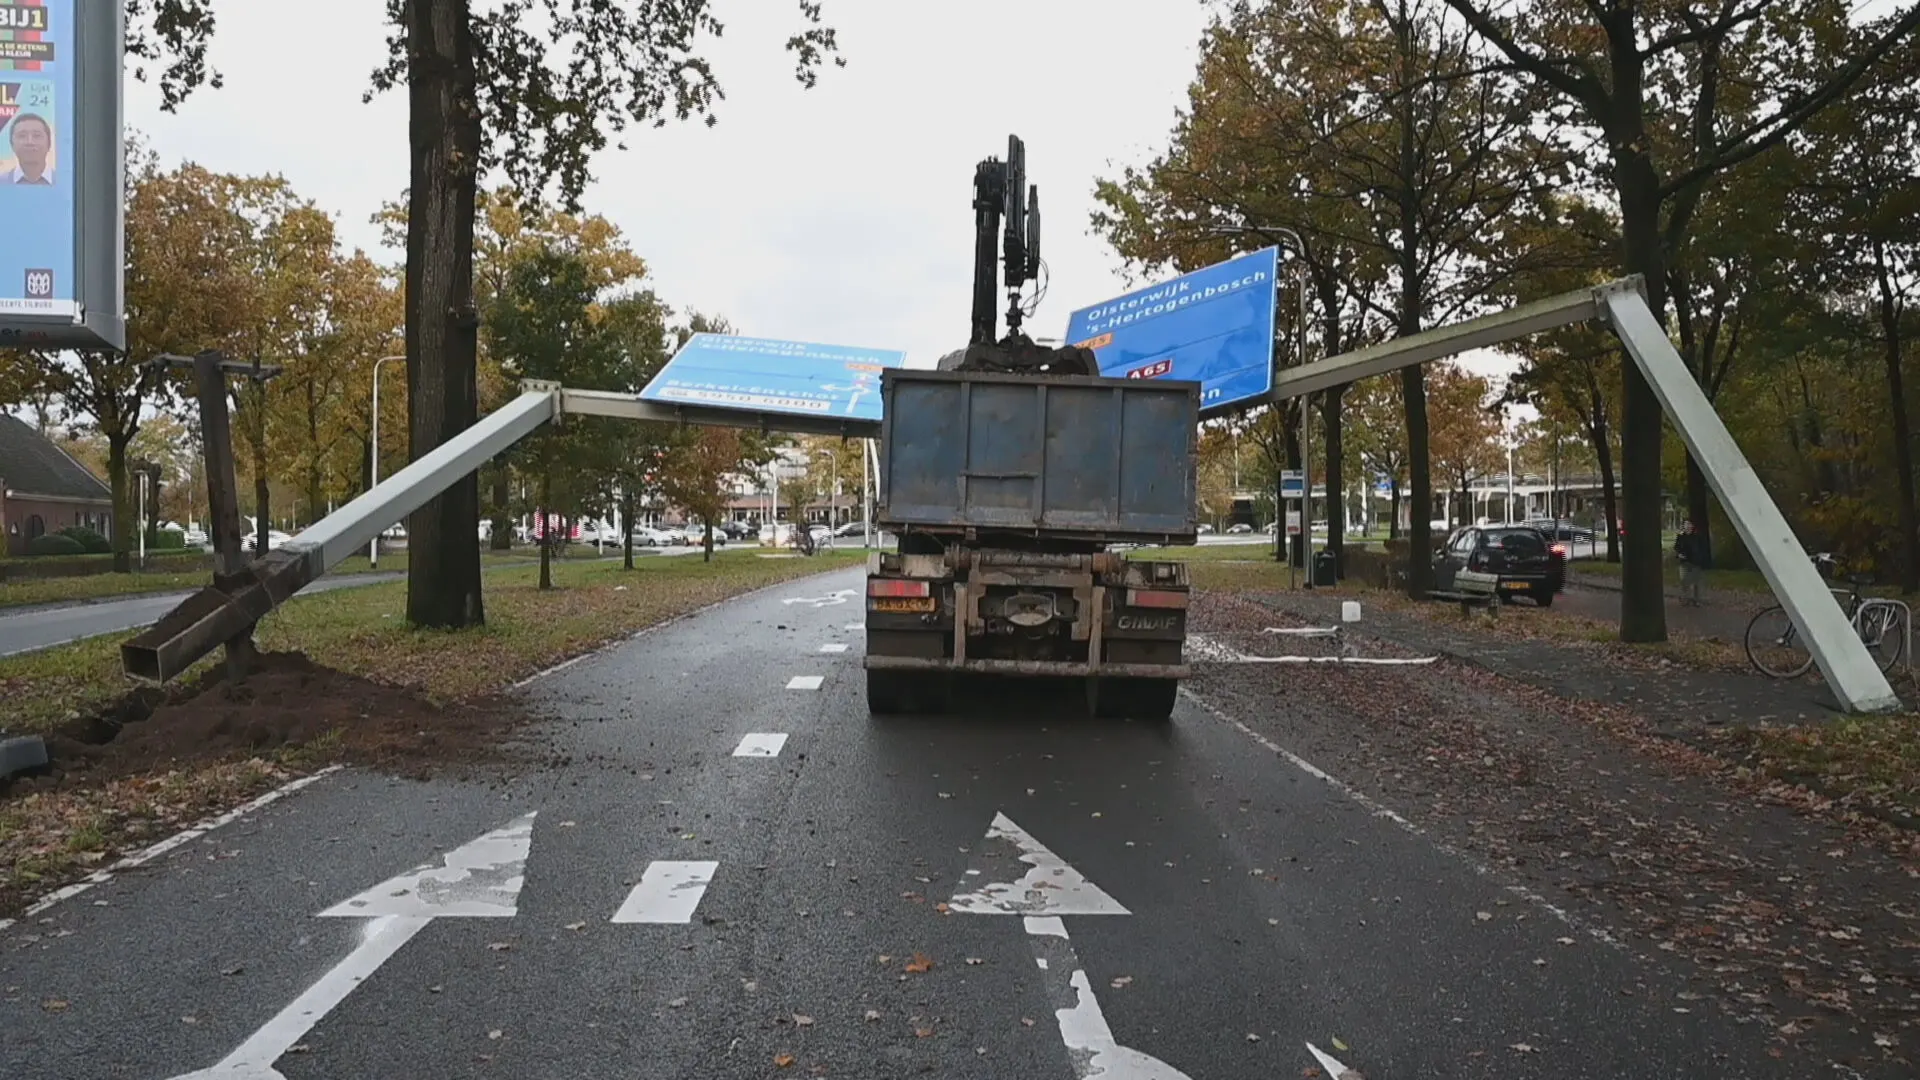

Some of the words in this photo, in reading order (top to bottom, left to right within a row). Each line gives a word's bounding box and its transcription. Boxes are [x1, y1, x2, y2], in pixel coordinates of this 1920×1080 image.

[0, 8, 43, 28] BIJ1
[29, 94, 50, 107] 24
[1086, 271, 1266, 334] 's-Hertogenbosch
[1087, 280, 1191, 321] Oisterwijk
[1130, 362, 1167, 380] A65
